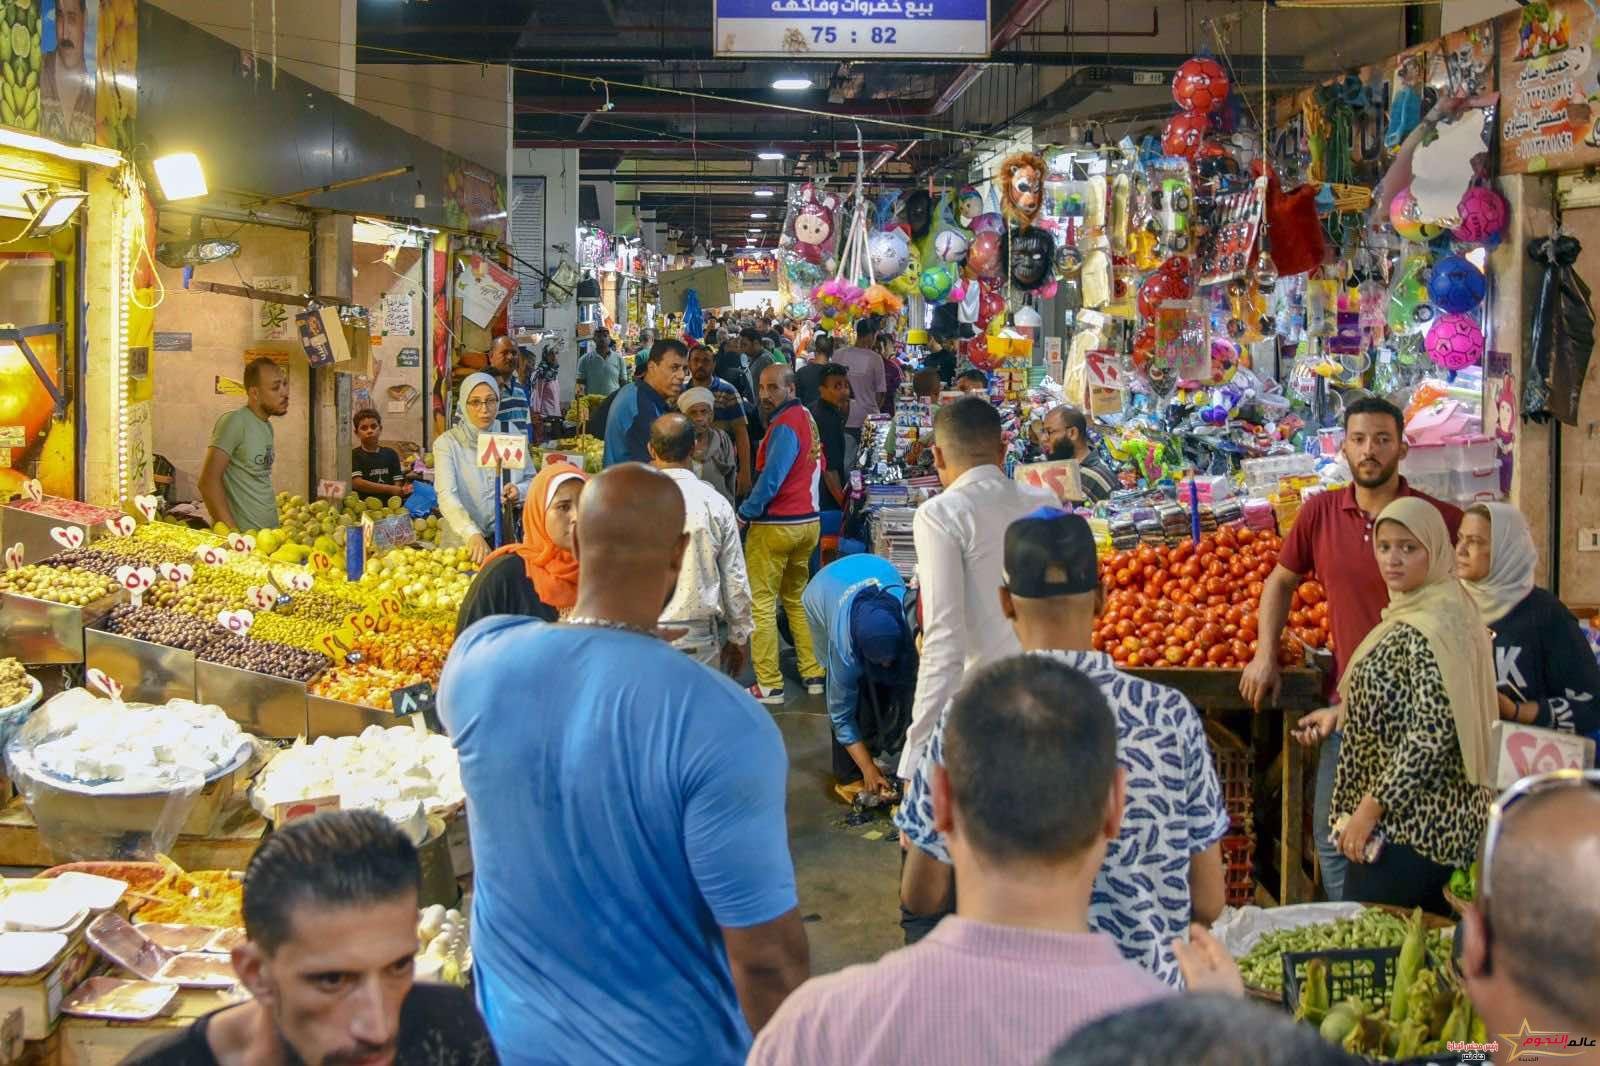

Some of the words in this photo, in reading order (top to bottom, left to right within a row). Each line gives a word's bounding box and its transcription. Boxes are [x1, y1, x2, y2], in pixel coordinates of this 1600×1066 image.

[905, 1, 933, 18] بيع
[811, 26, 837, 44] 75
[871, 26, 897, 44] 82
[126, 572, 149, 588] ٥٠
